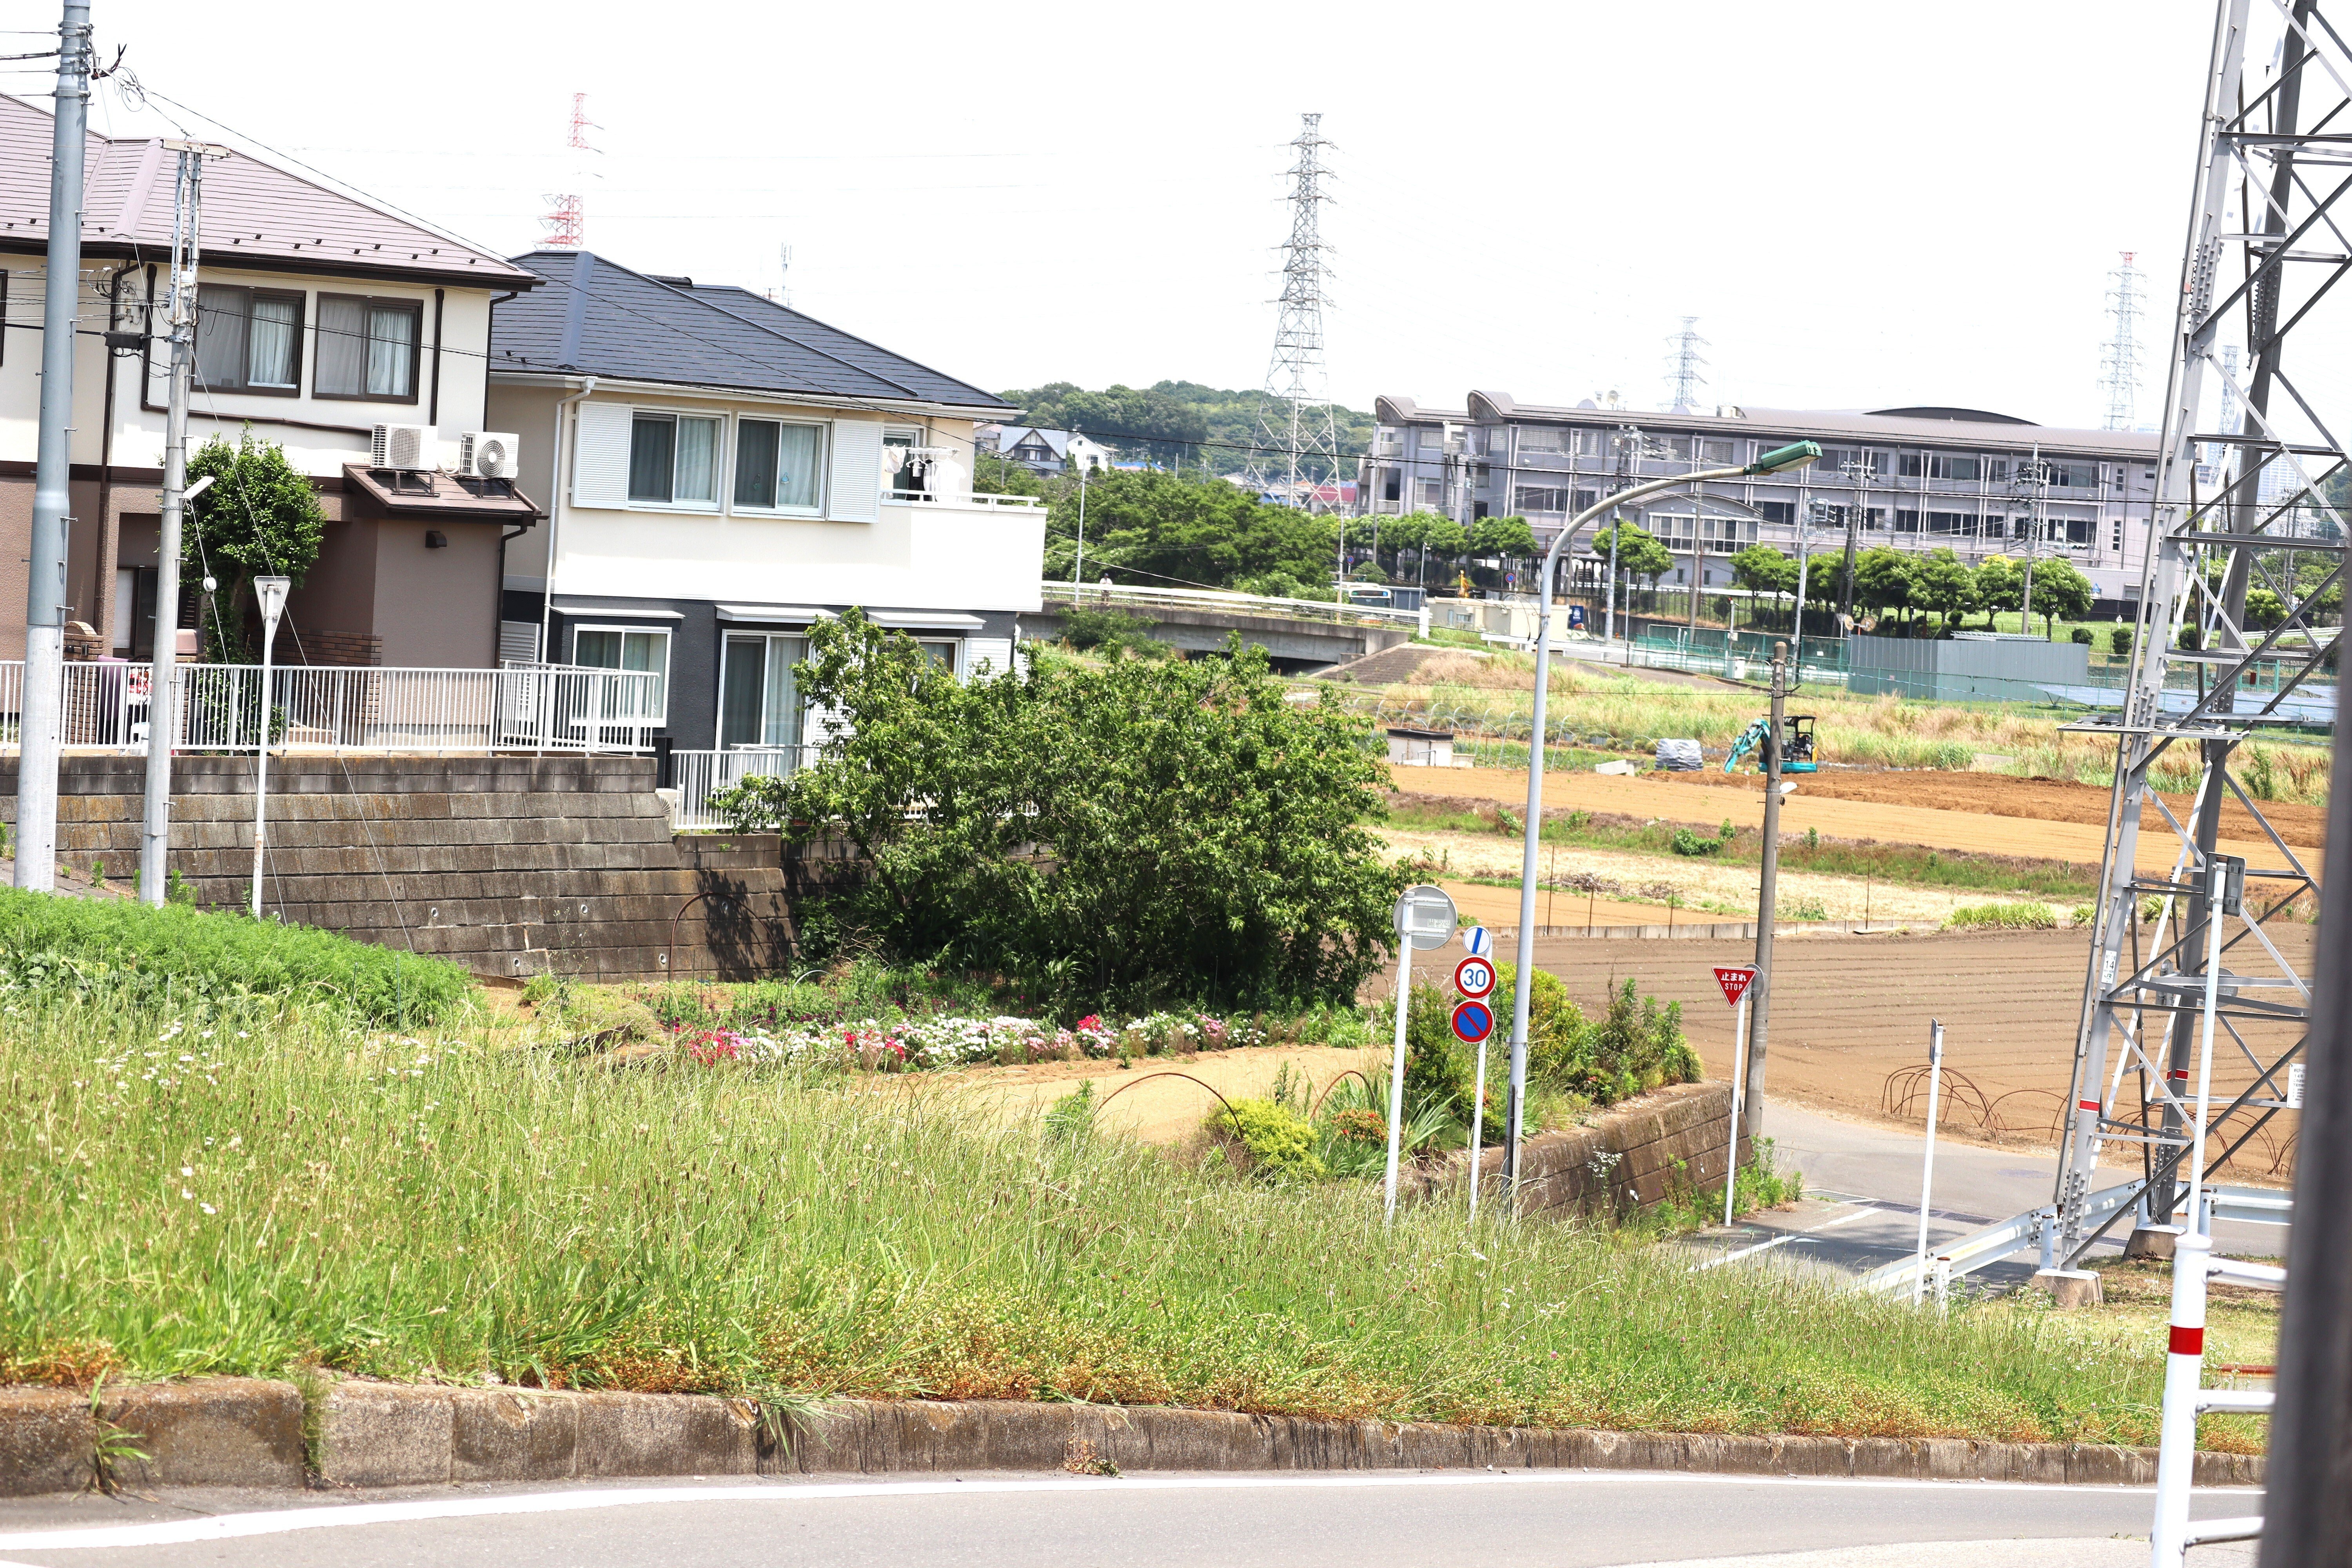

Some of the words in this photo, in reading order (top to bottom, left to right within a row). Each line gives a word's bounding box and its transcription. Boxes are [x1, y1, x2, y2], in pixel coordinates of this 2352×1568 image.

[2106, 960, 2114, 969] 14
[1464, 969, 1486, 987] 30
[1720, 972, 1747, 982] 止まれ
